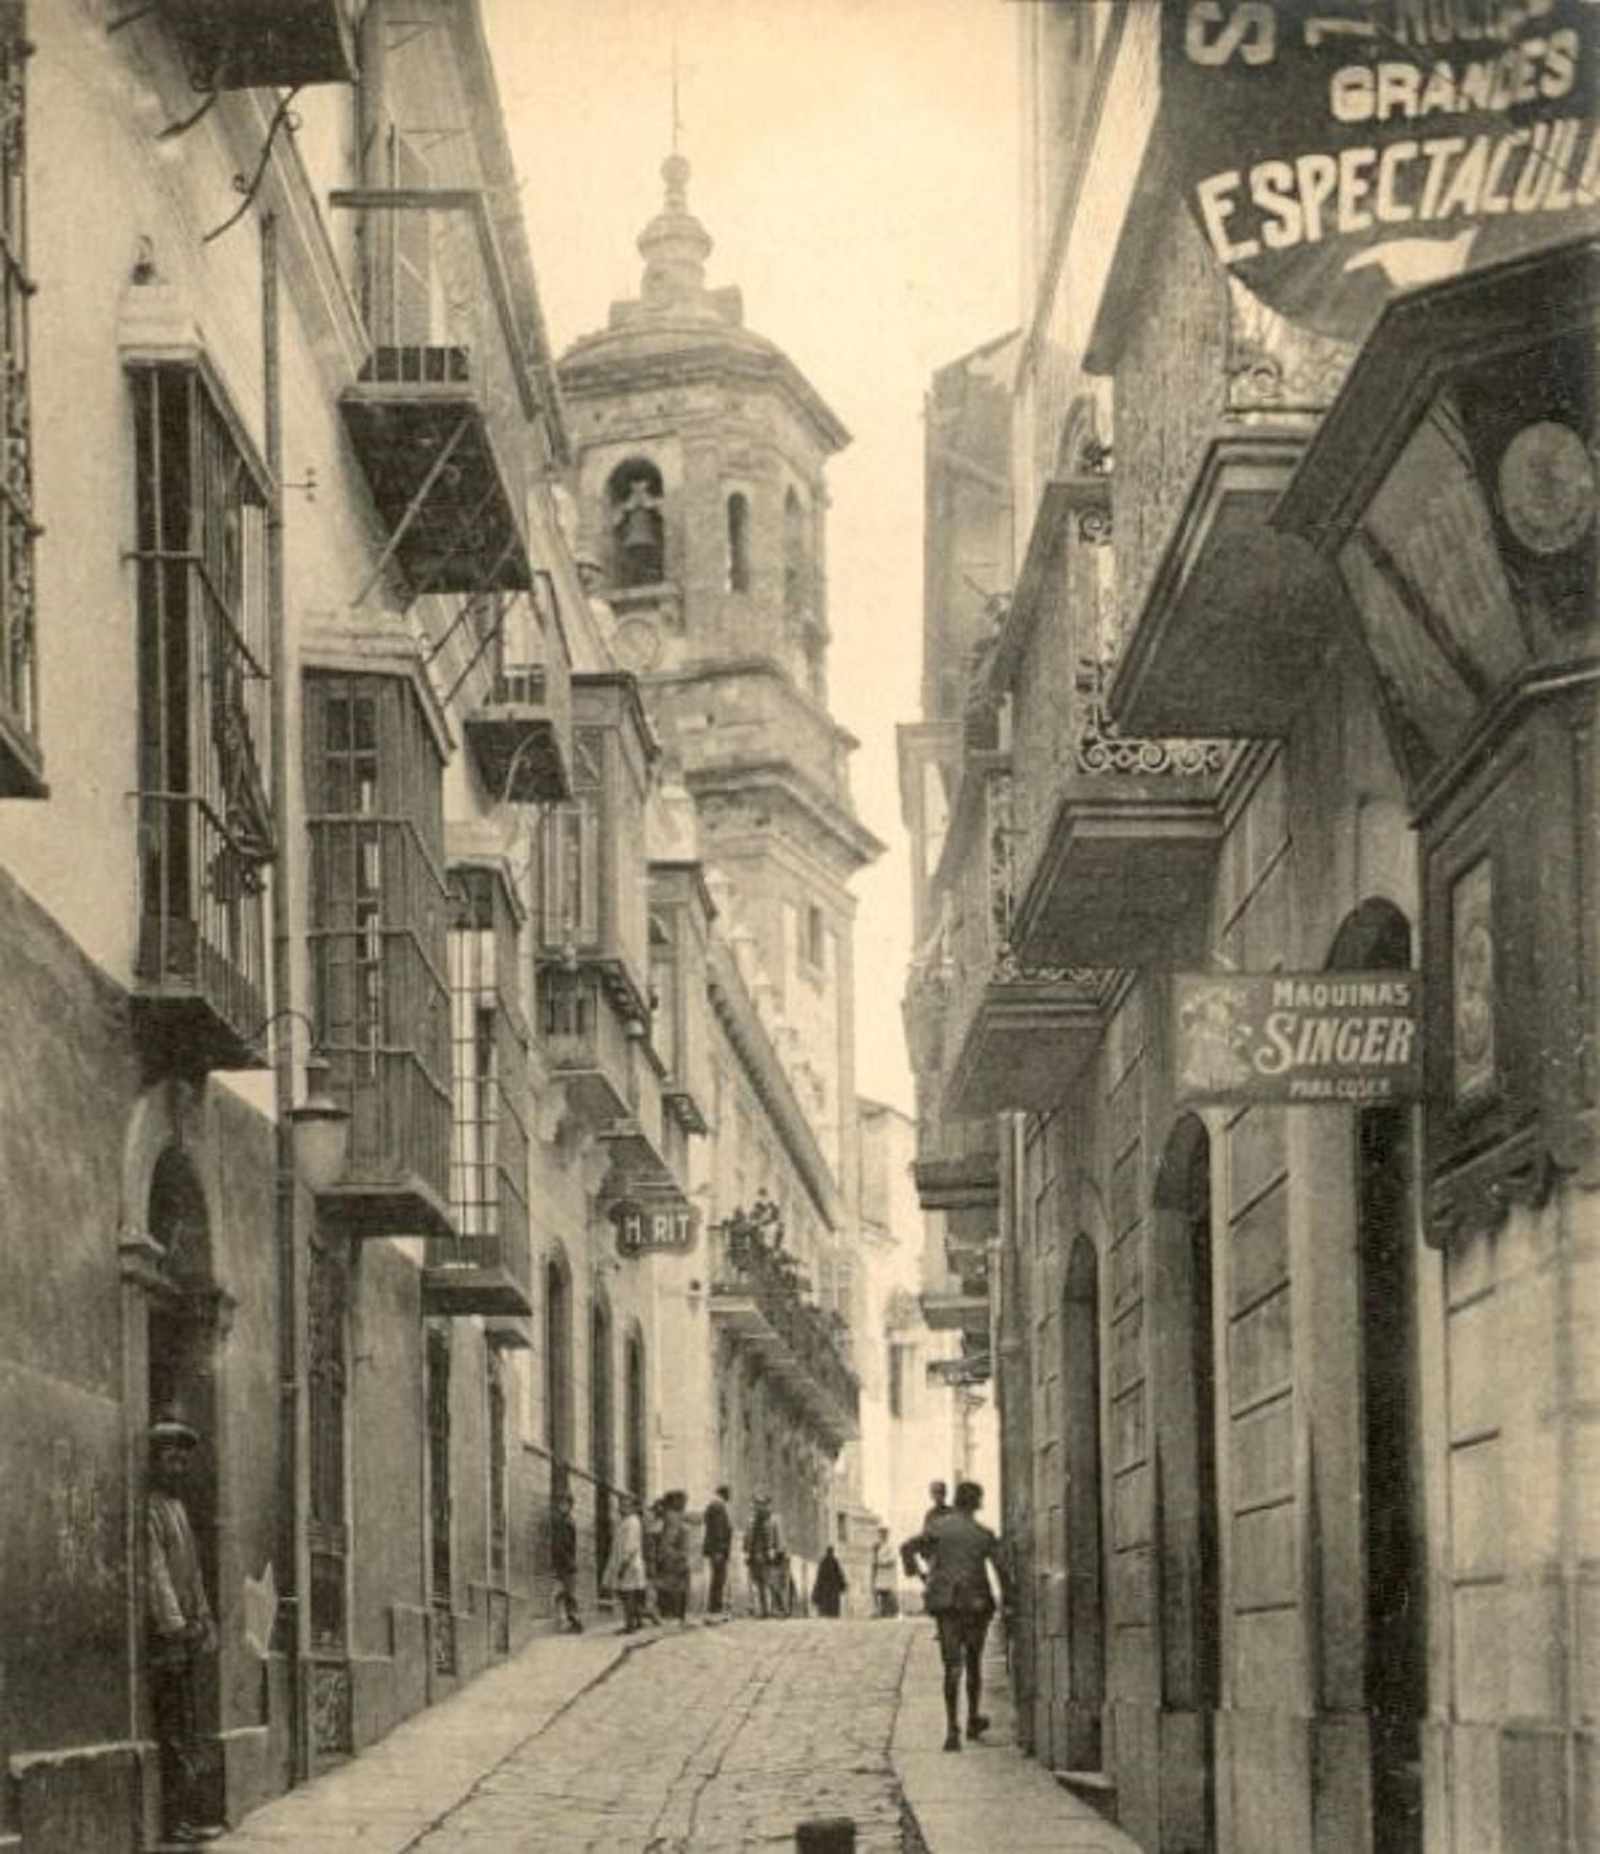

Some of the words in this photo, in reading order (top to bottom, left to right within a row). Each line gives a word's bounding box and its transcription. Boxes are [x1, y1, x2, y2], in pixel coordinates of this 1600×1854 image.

[1330, 28, 1580, 123] GRANDES
[1272, 980, 1411, 1008] MAQUINAS
[1253, 1012, 1415, 1075] SINGER
